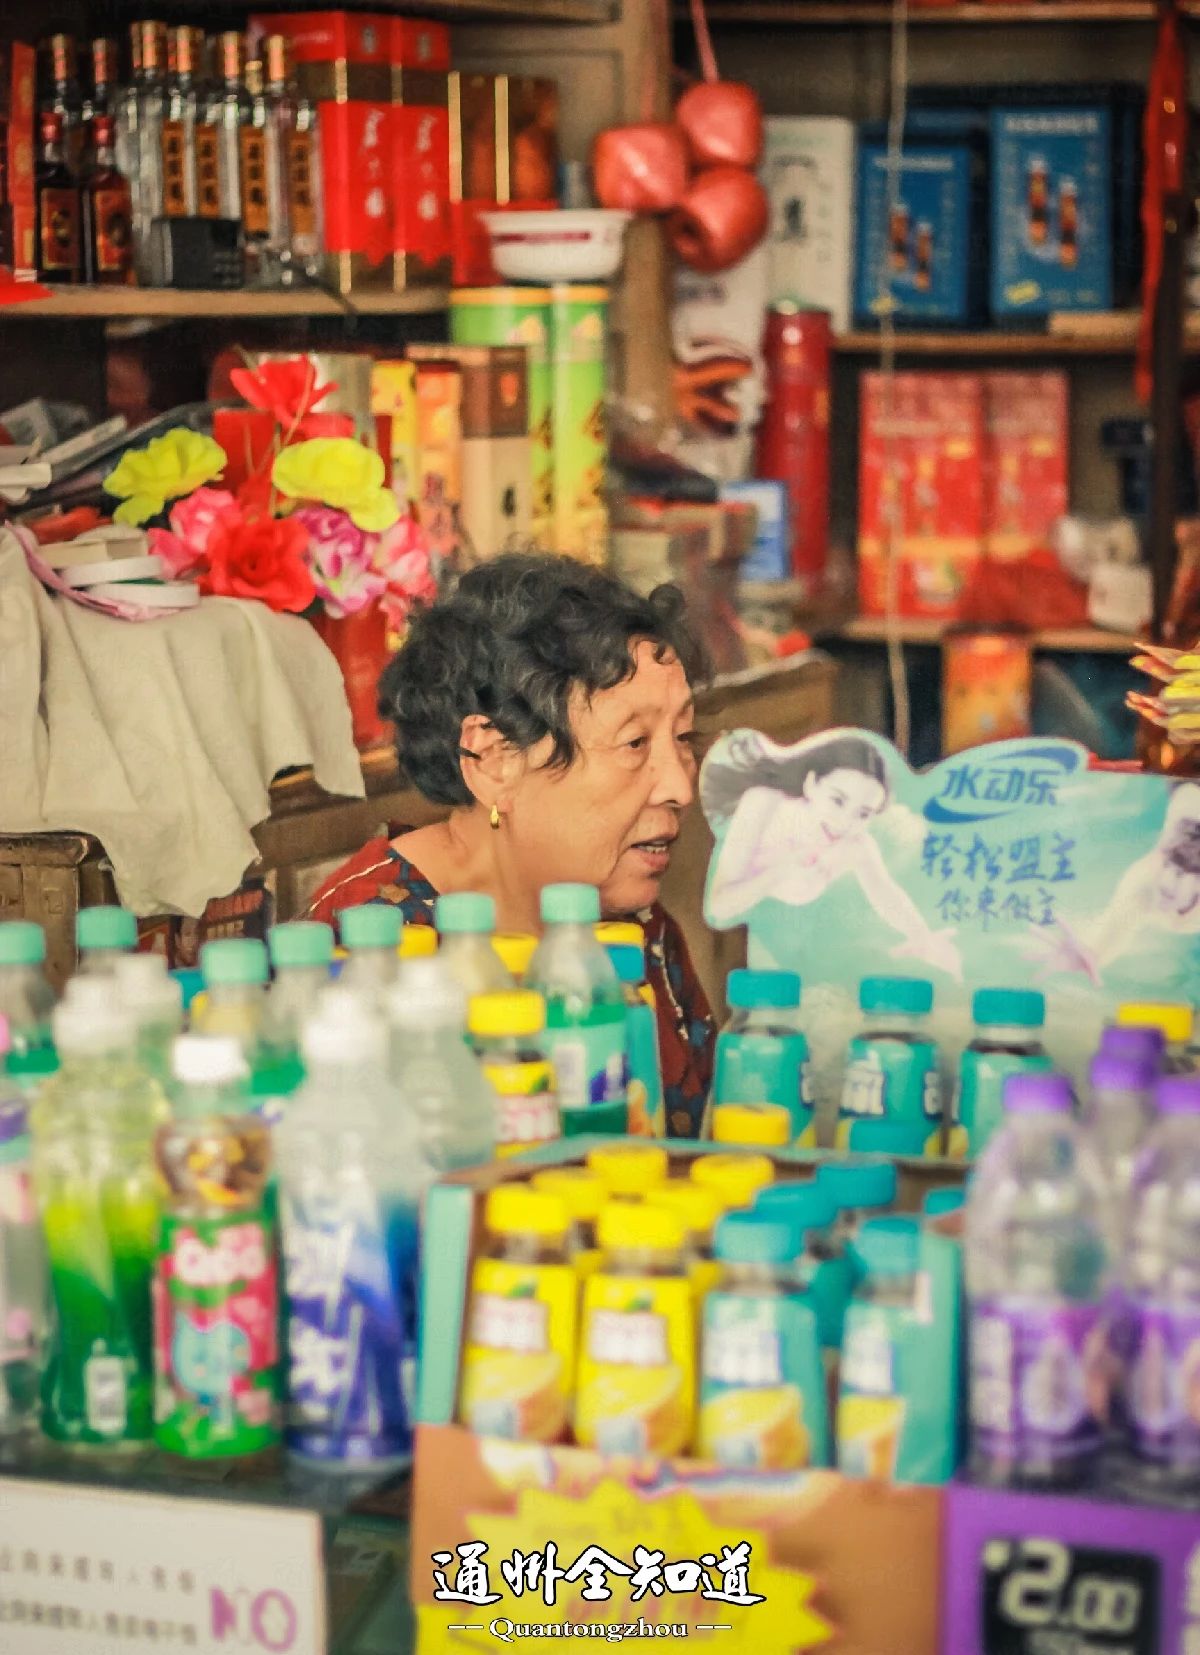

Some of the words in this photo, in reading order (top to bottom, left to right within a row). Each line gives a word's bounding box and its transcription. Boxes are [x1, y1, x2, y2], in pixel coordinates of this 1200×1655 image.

[940, 766, 1061, 806] 水动乐
[920, 831, 1079, 882] 轻松盟主
[936, 885, 1058, 932] 你来做主
